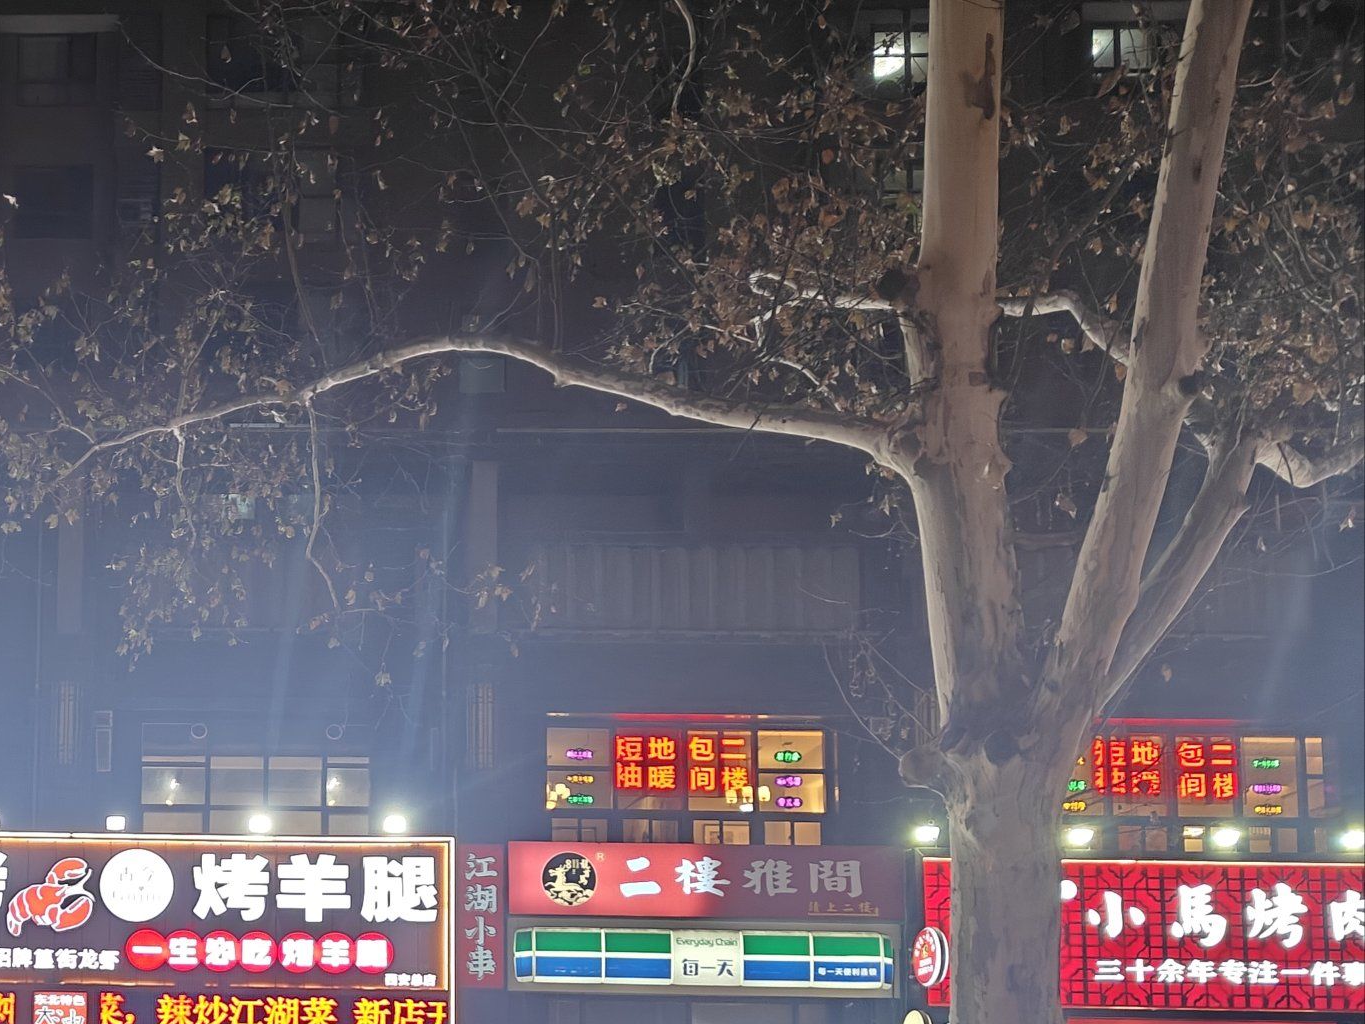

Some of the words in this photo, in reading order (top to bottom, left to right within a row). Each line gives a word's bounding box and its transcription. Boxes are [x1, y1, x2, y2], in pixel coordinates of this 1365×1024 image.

[648, 737, 676, 790] 地暖
[689, 737, 715, 790] 包间
[721, 739, 748, 790] 二楼
[1178, 743, 1205, 797] 包间
[1210, 744, 1233, 797] 二楼
[193, 853, 438, 922] 烤羊腿
[619, 856, 864, 899] 二樓雅間
[464, 853, 497, 981] 江湖小串
[676, 938, 714, 947] Everyday
[716, 938, 738, 946] Chain
[34, 994, 85, 1006] 东北特色
